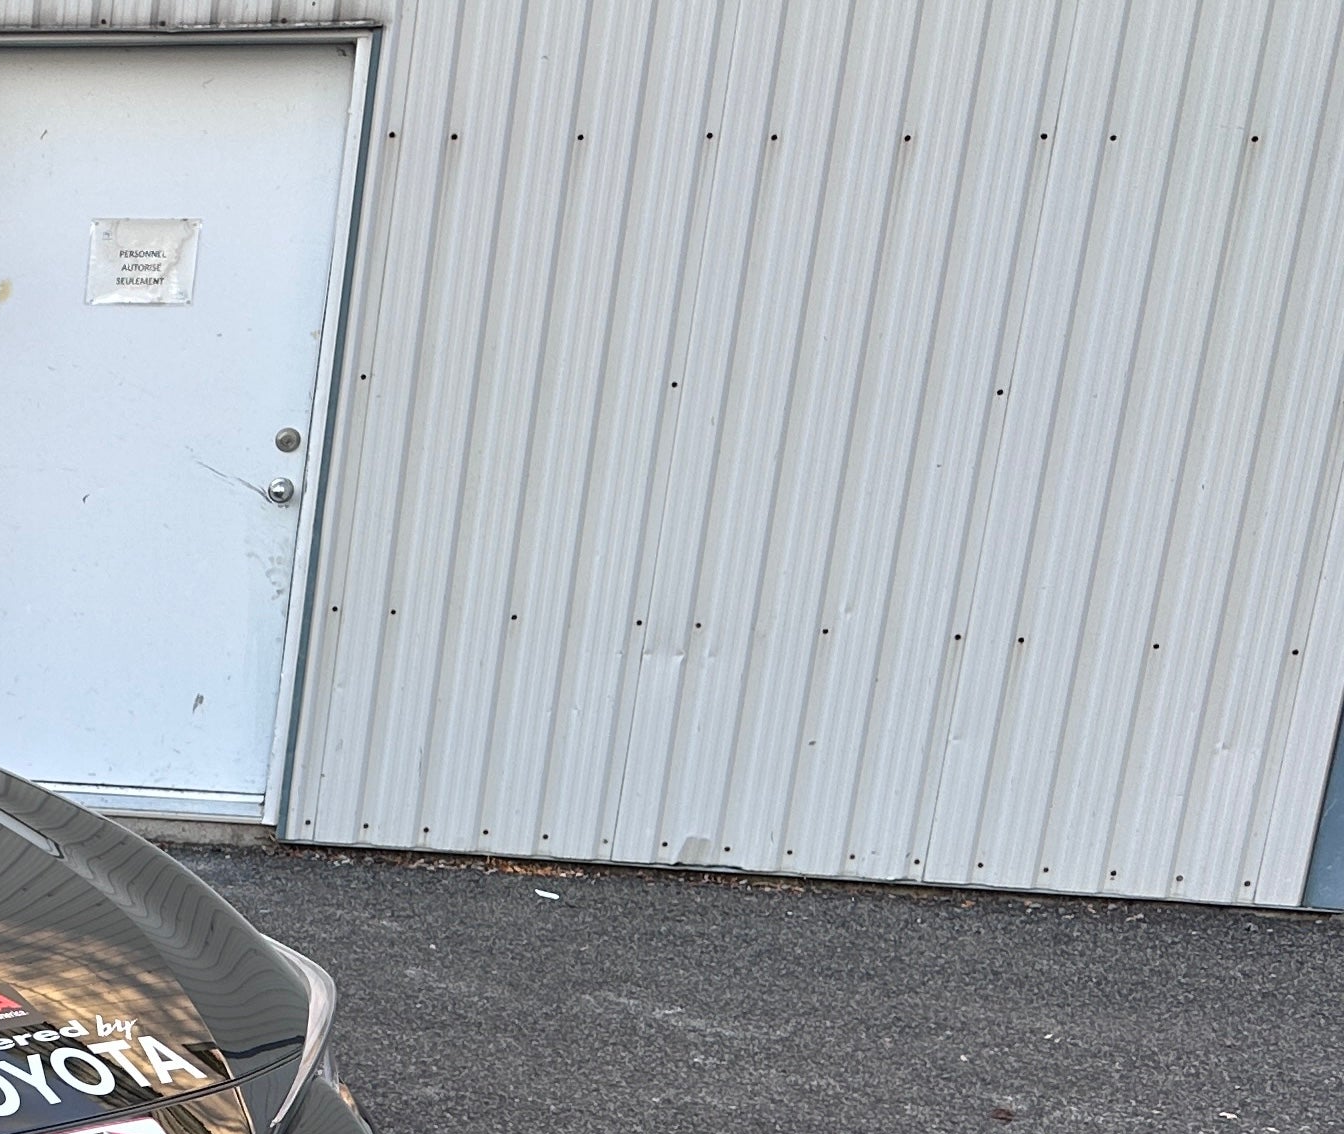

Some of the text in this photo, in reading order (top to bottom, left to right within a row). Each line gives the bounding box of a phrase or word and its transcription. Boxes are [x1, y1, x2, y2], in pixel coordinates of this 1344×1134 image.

[119, 250, 166, 258] PERSONNEL
[116, 277, 165, 285] SEULEMENT
[96, 1015, 139, 1040] by
